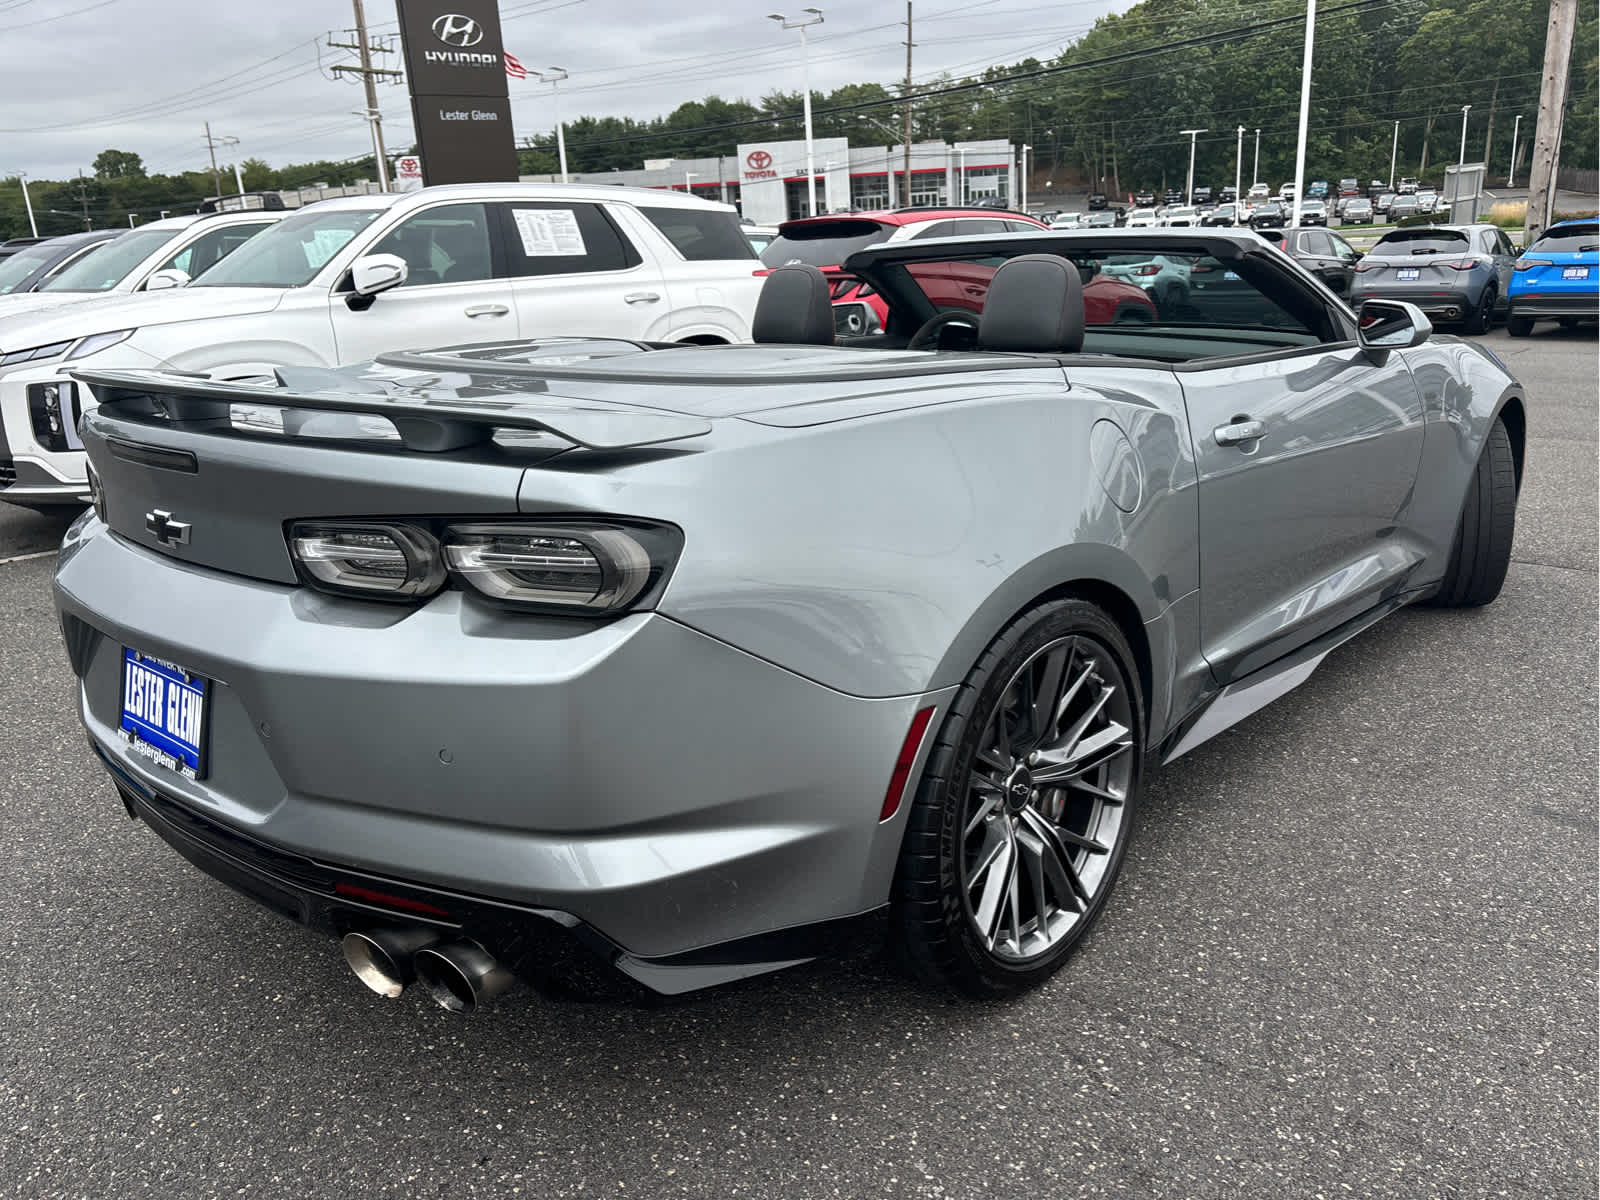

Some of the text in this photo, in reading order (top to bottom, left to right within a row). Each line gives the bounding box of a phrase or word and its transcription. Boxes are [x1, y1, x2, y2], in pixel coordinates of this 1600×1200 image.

[424, 51, 497, 63] HYUNDAI
[440, 109, 498, 120] Lester Glenn
[744, 170, 777, 178] TOYOTA
[124, 662, 203, 749] LESTER GLENN
